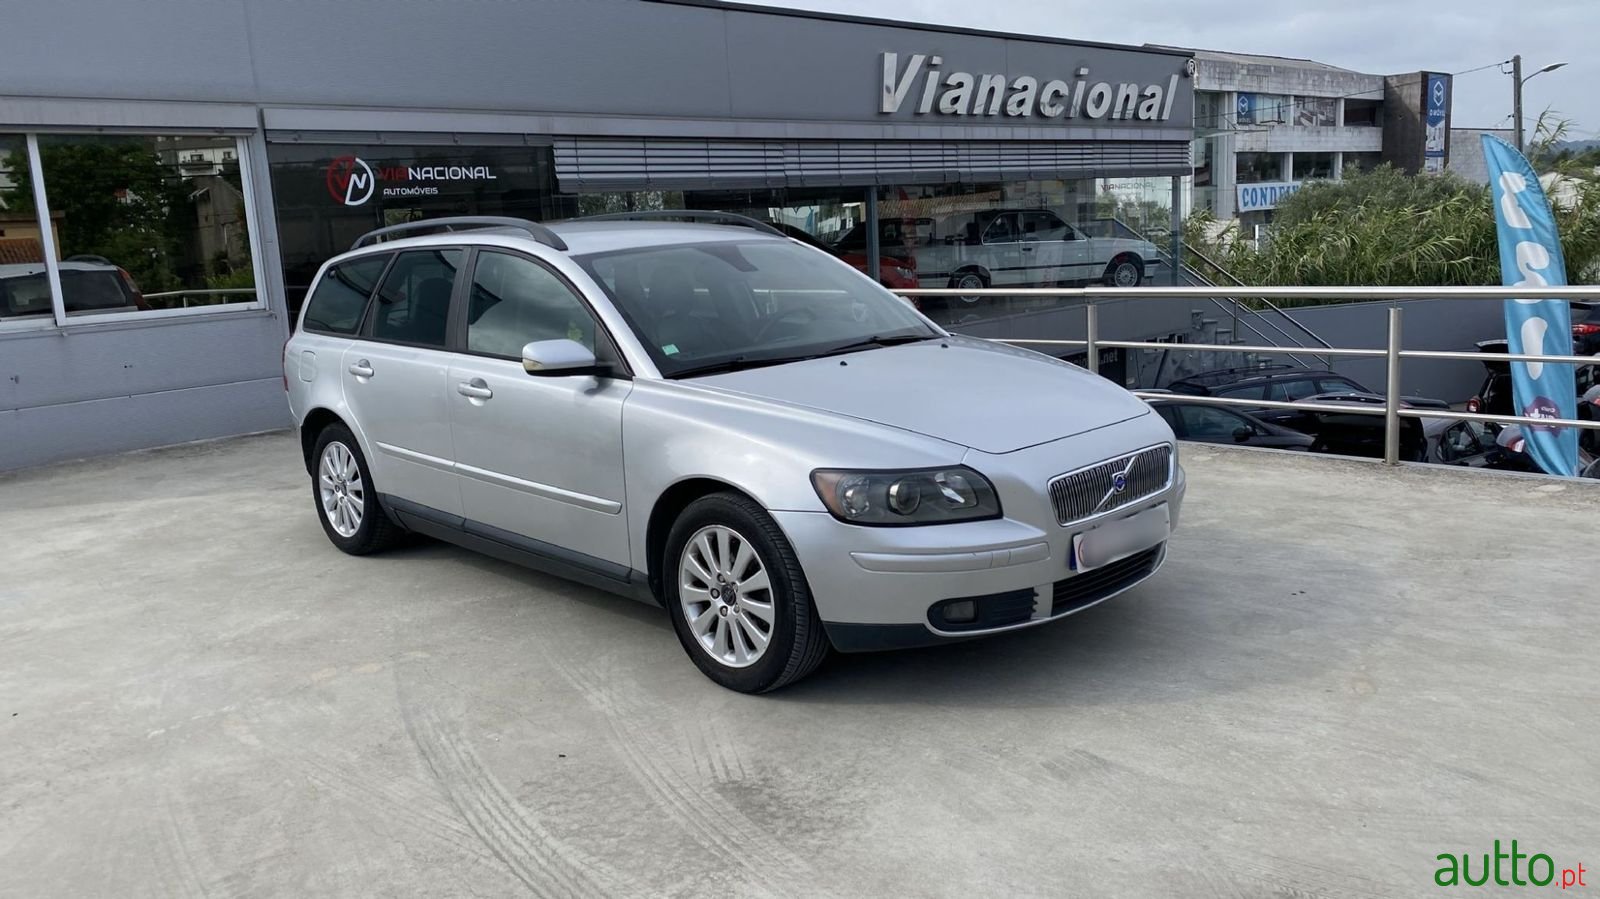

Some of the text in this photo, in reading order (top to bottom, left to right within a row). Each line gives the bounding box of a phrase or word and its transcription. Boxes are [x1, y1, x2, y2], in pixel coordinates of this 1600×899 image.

[879, 51, 1180, 121] Vianacional
[380, 166, 497, 180] VIANACIONAL
[383, 186, 439, 196] AUTOMÓVEIS
